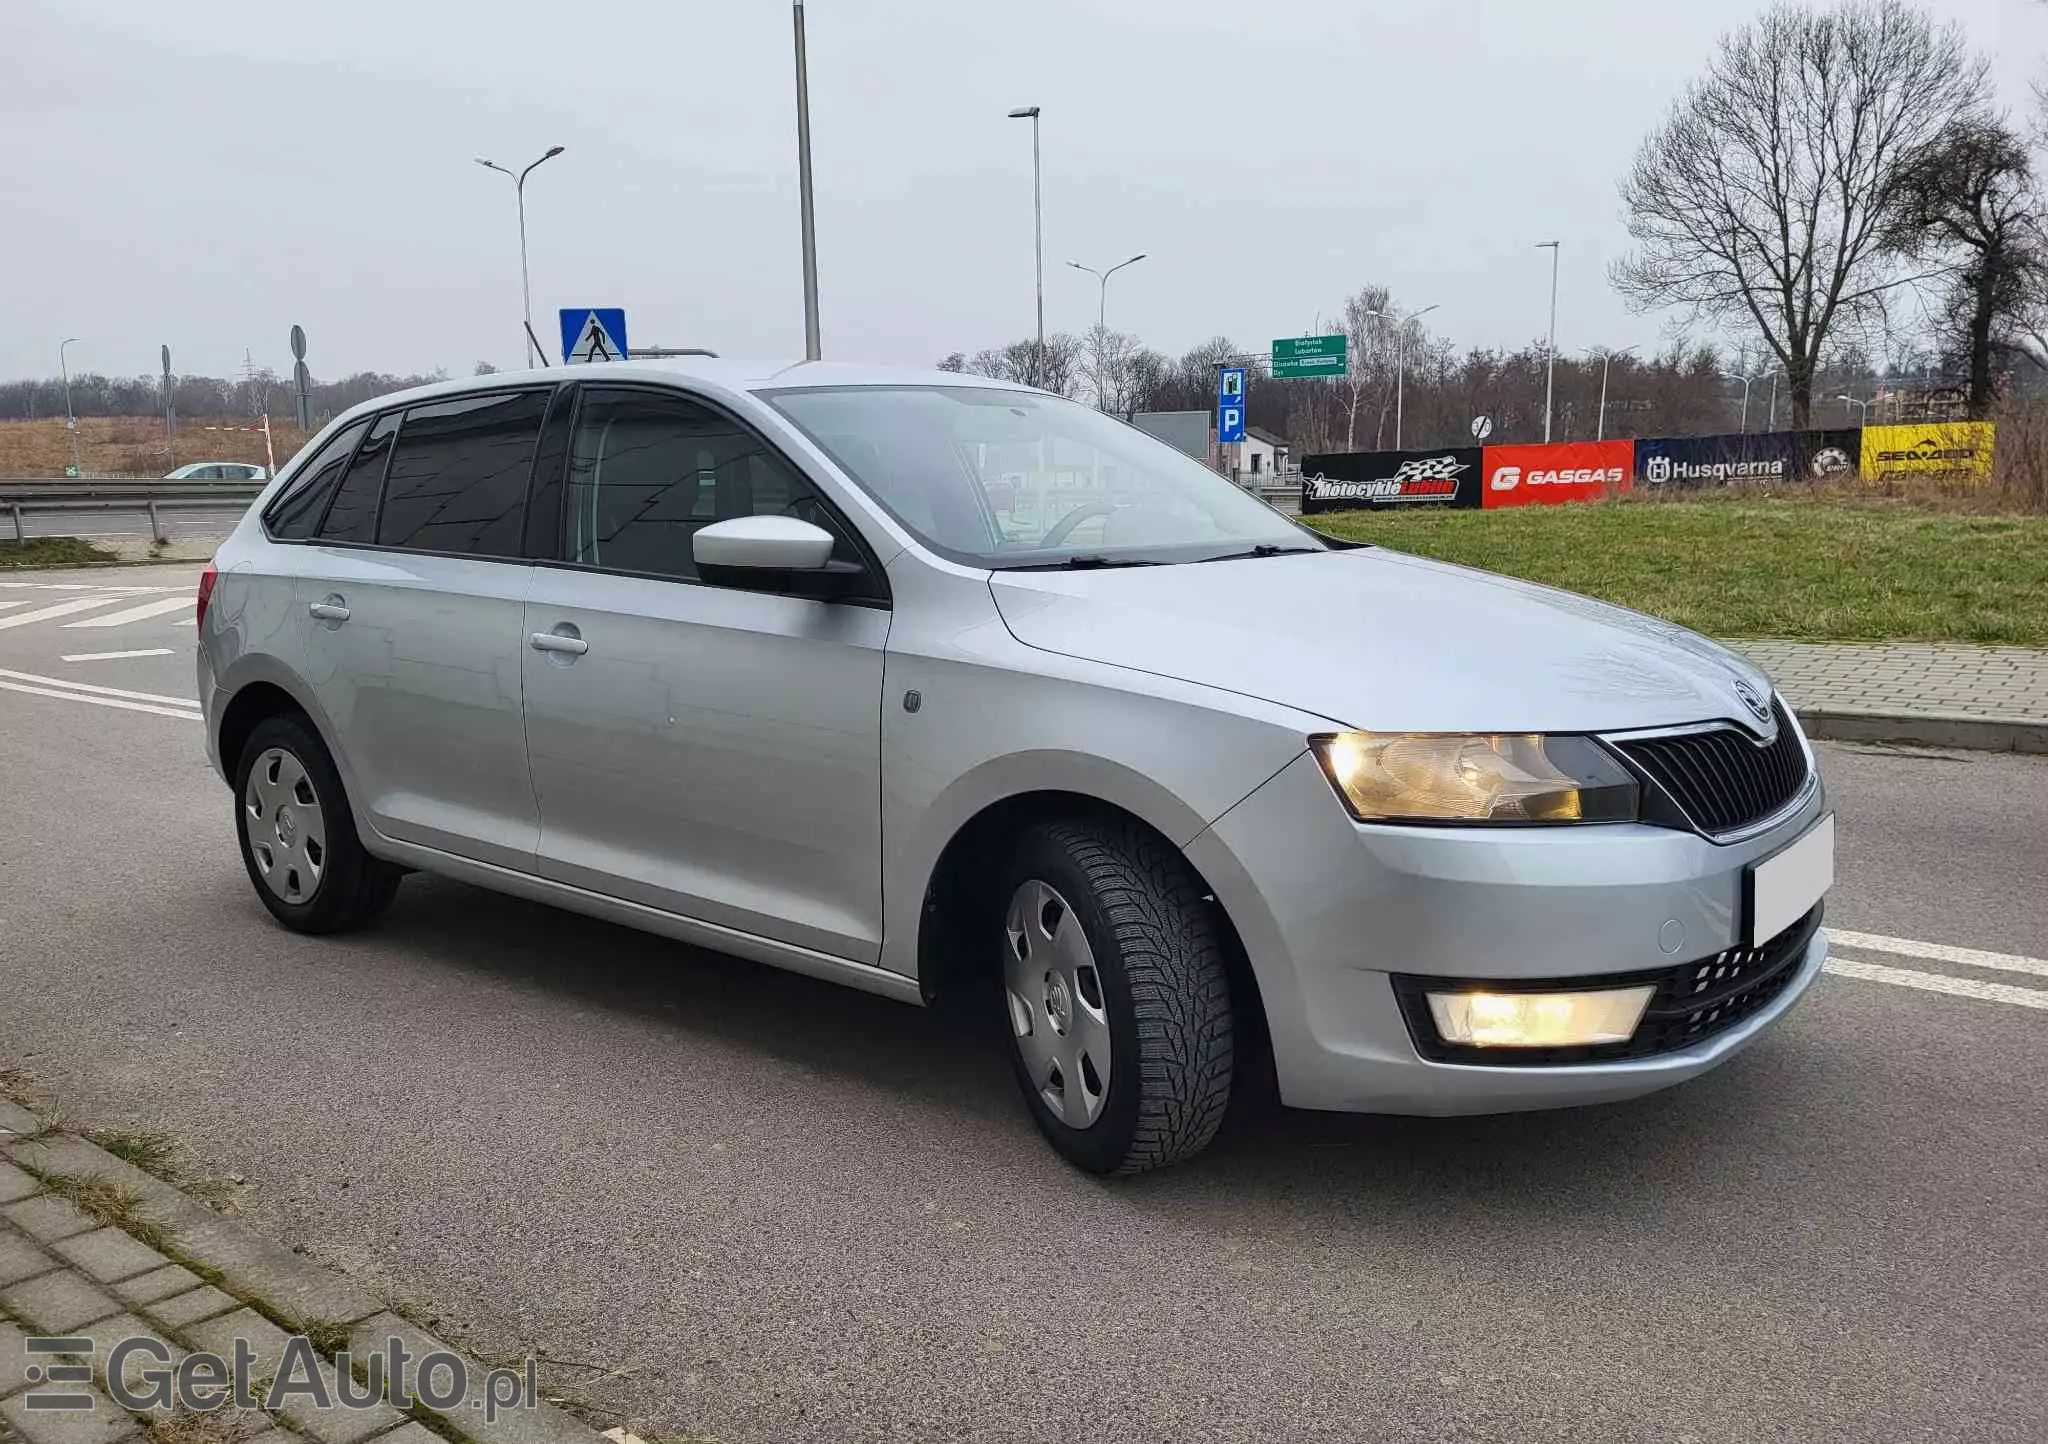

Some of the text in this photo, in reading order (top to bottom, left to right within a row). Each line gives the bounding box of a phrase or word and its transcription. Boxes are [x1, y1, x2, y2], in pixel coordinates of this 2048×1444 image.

[1224, 409, 1239, 433] P
[1527, 468, 1623, 484] GASGAS
[1673, 461, 1782, 480] Husqvarna
